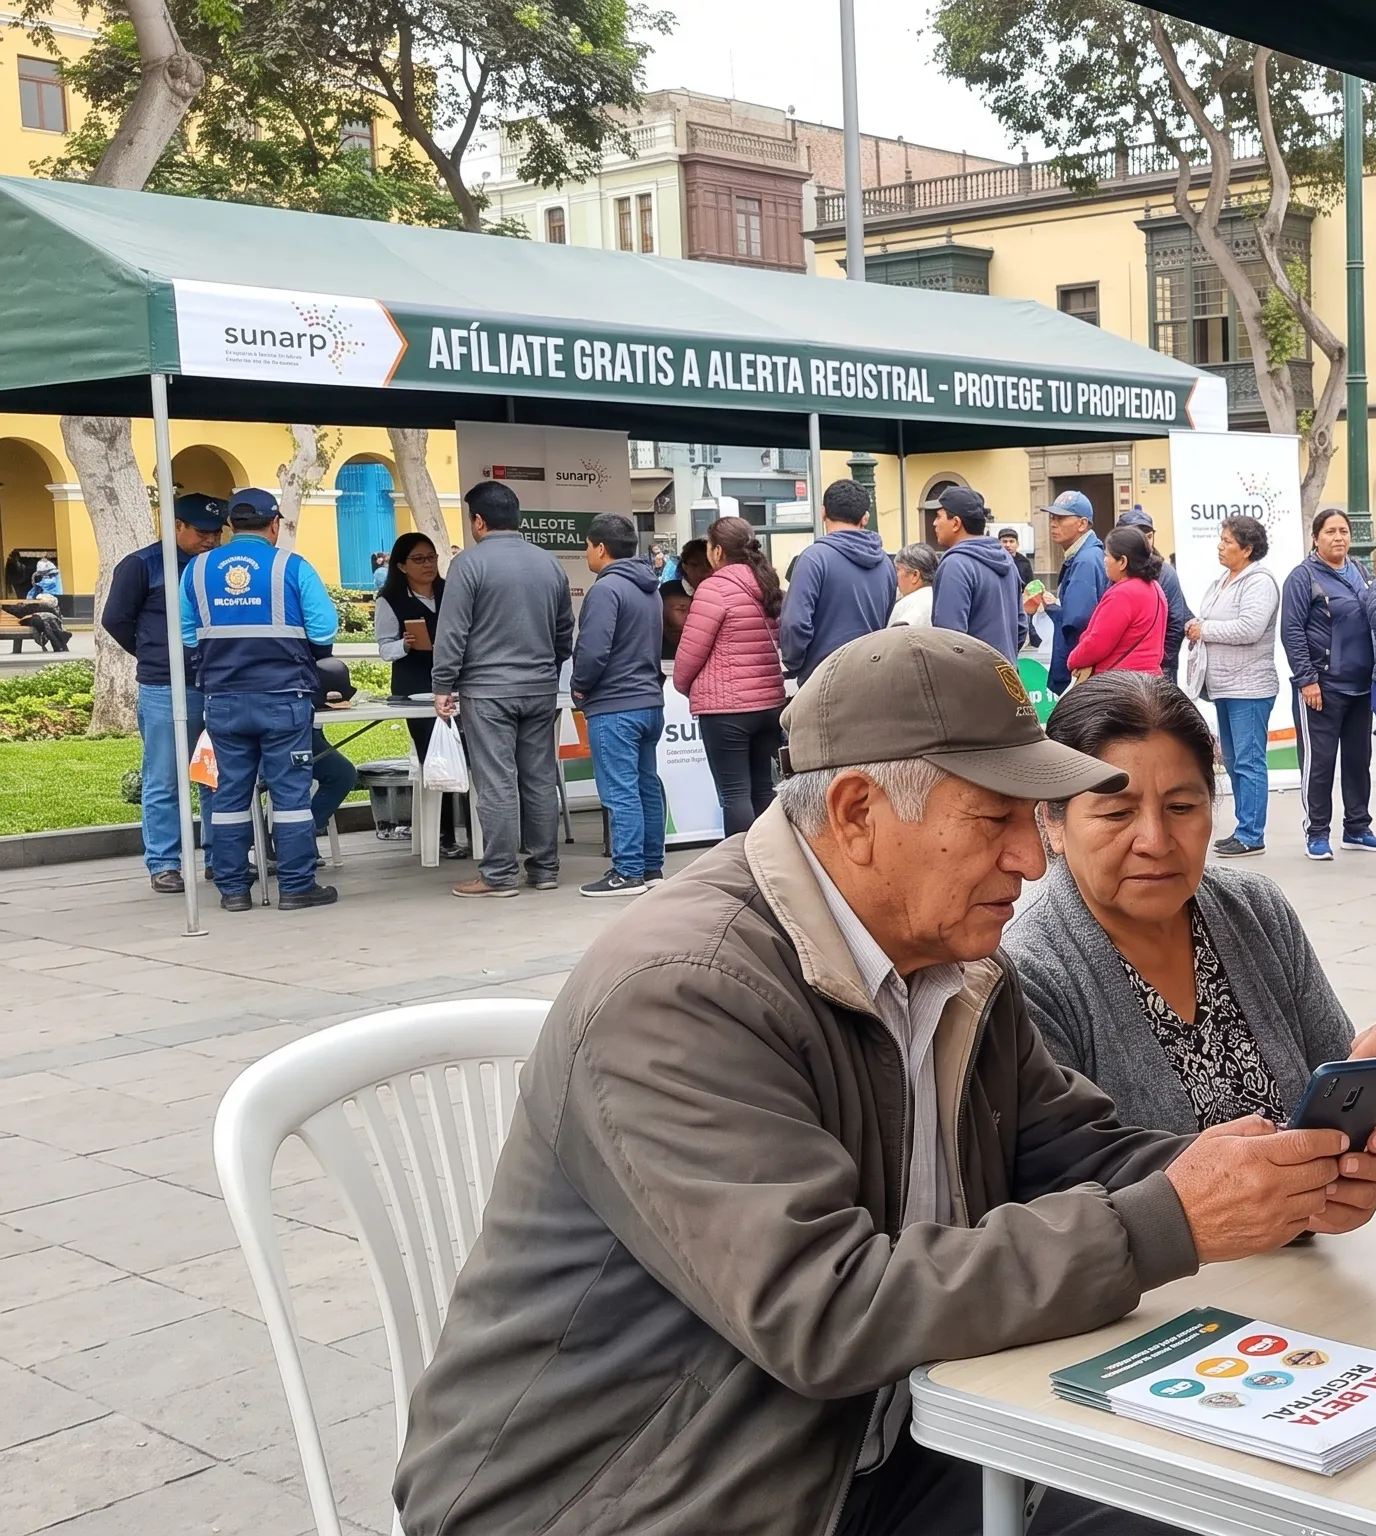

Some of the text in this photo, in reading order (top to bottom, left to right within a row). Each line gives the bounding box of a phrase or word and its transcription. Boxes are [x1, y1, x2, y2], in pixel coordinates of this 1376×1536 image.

[224, 325, 327, 356] sunarp
[428, 321, 1176, 422] AFÍLIATE GRATIS A ALERTA REGISTRAL - PROTEGE TU PROPIEDAD
[555, 470, 597, 485] sunarp
[1190, 503, 1264, 521] sunarp
[1261, 1363, 1374, 1420] REGISTRAL
